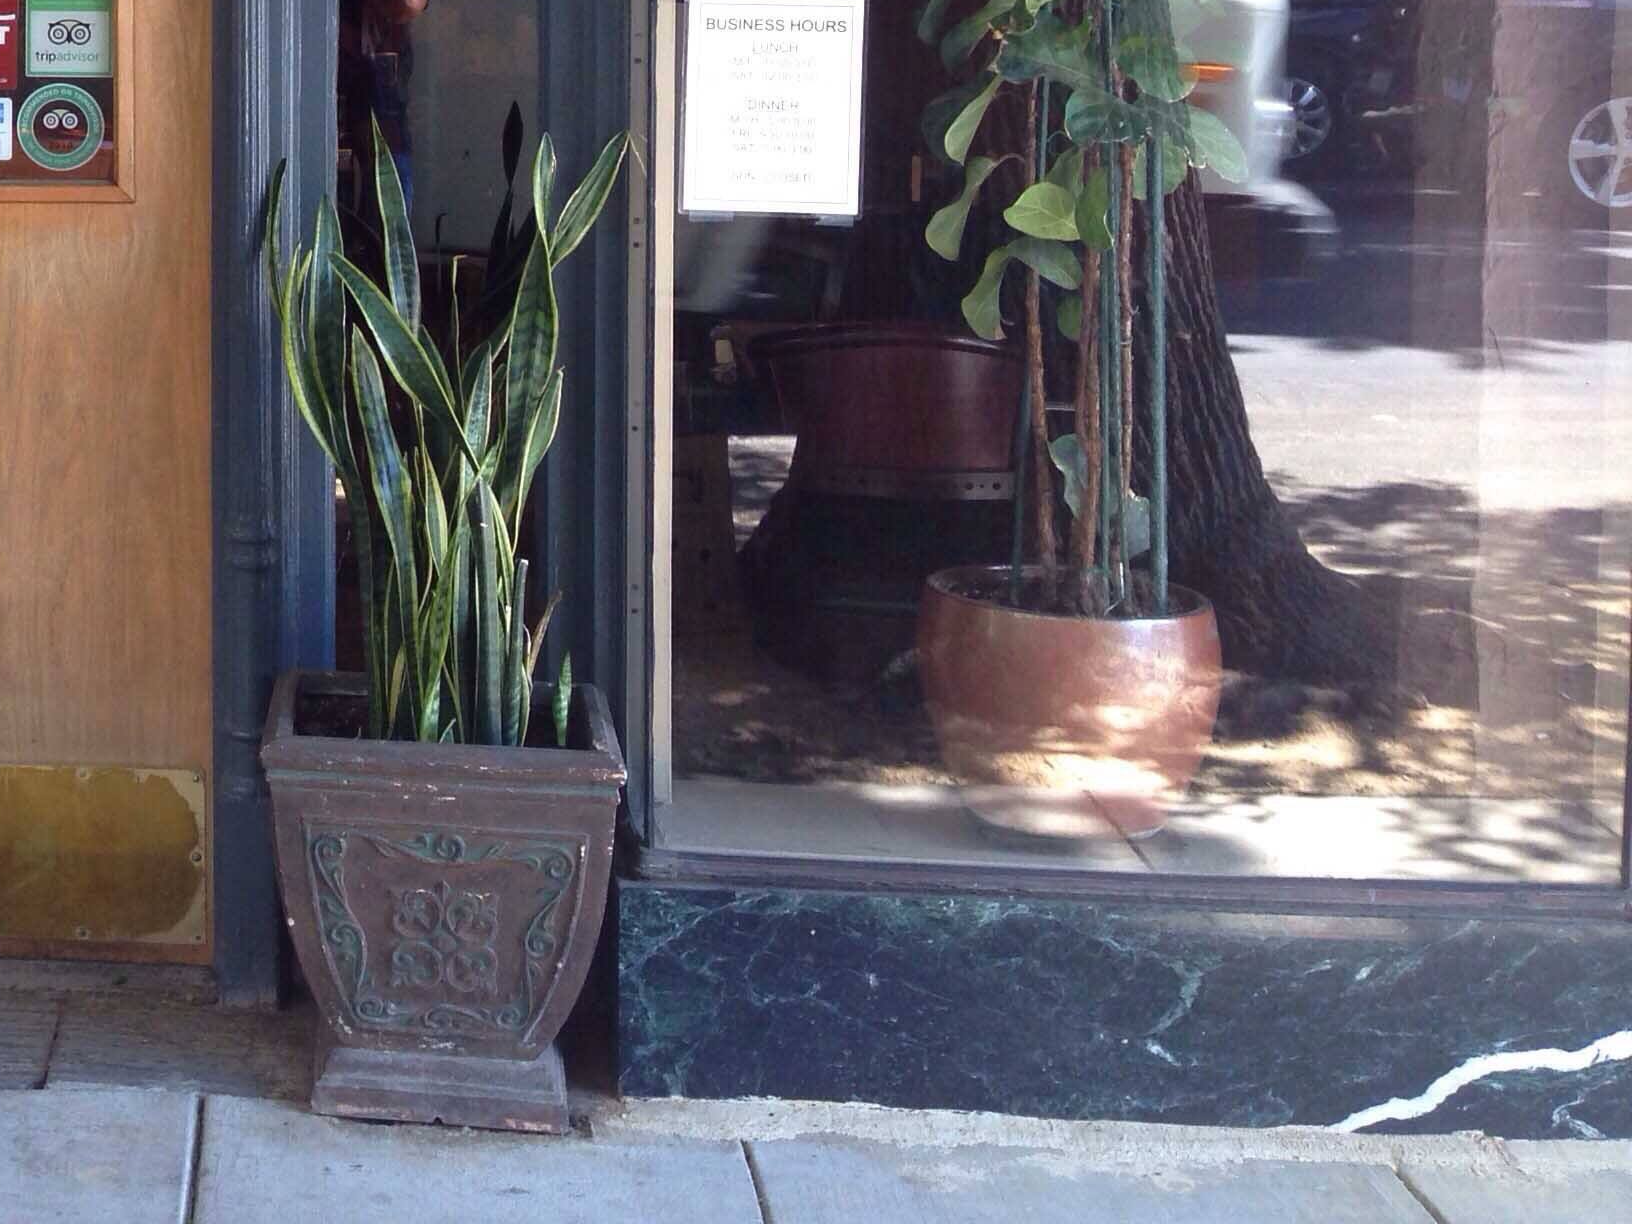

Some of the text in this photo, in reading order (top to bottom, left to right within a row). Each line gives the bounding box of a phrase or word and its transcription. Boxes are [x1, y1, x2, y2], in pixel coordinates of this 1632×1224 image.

[705, 17, 848, 33] BUSINESS HOURS
[35, 50, 100, 64] tripadvisor
